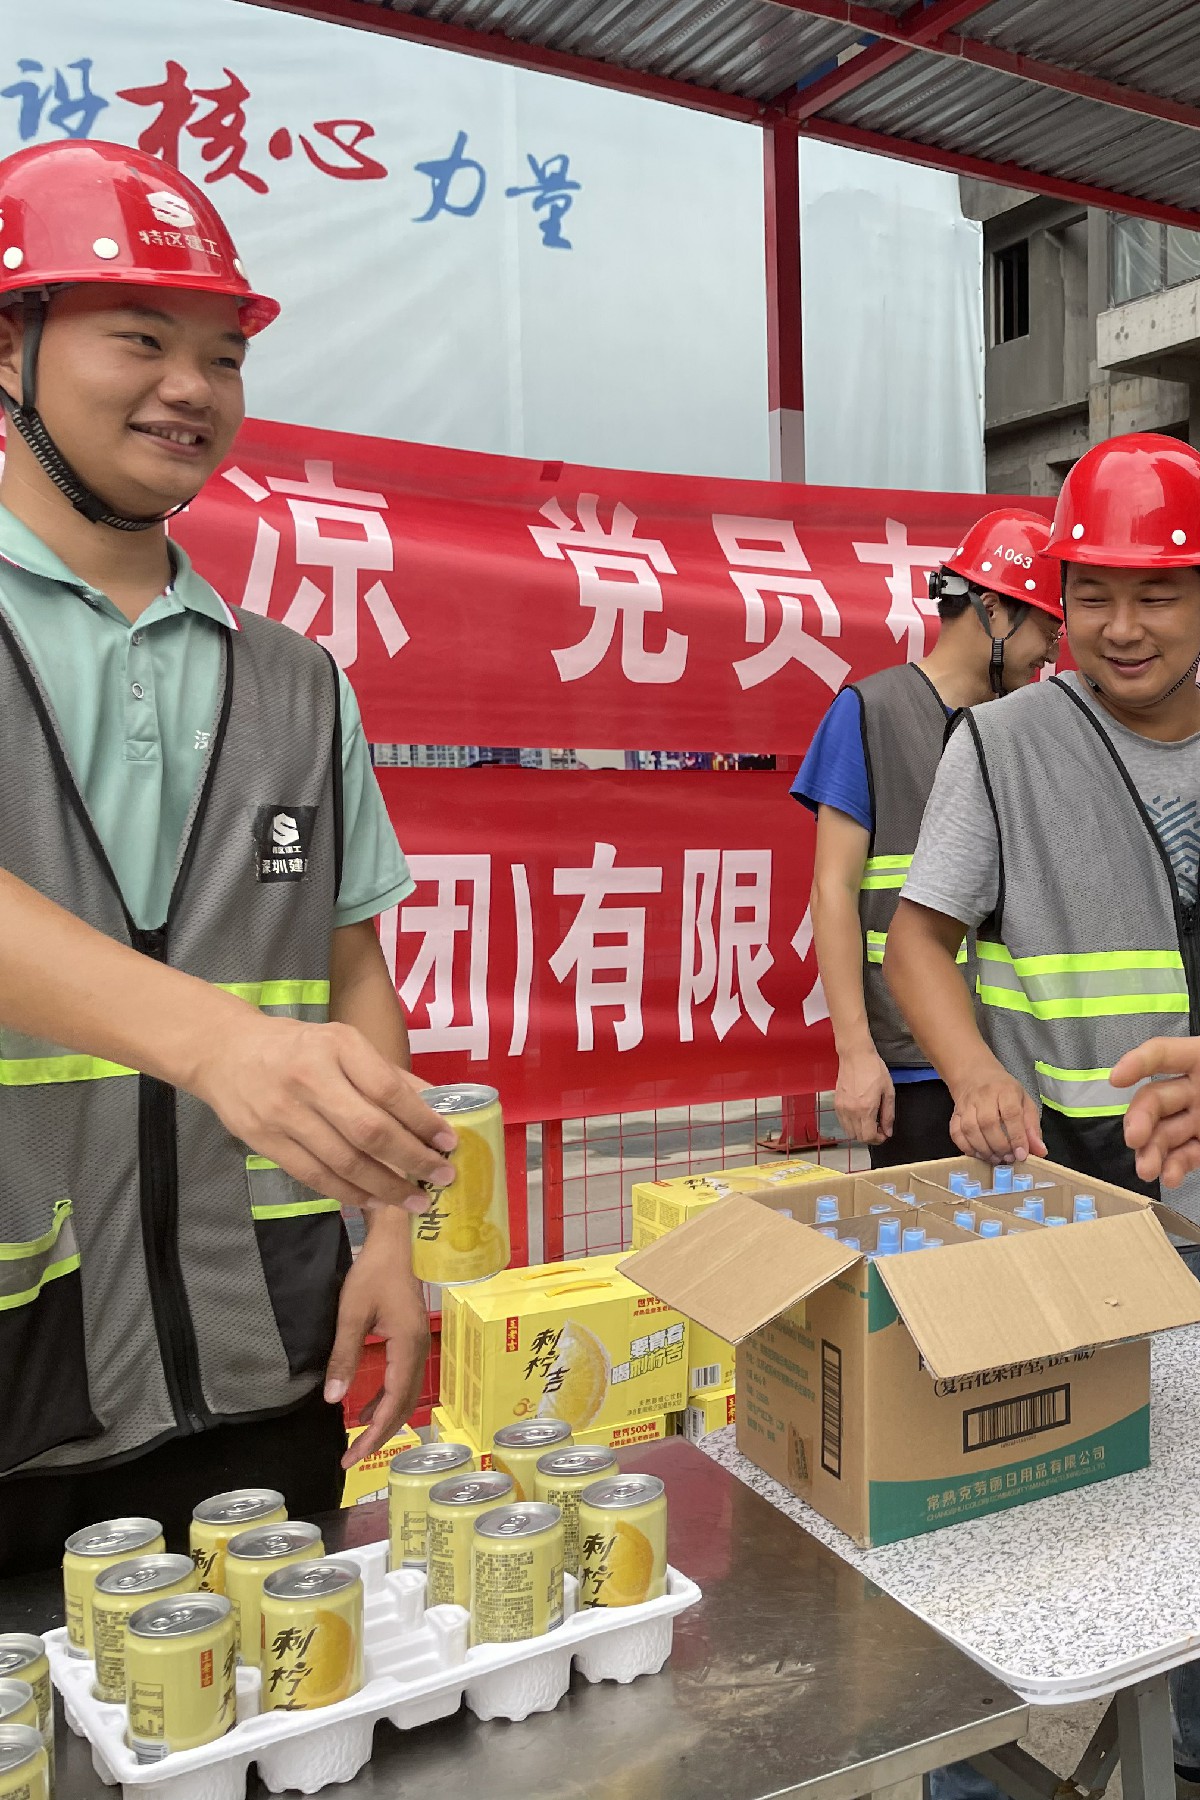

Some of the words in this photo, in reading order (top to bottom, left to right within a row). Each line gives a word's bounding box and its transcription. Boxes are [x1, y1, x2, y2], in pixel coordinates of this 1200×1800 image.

[138, 229, 222, 258] 特区建工
[993, 544, 1033, 570] A063
